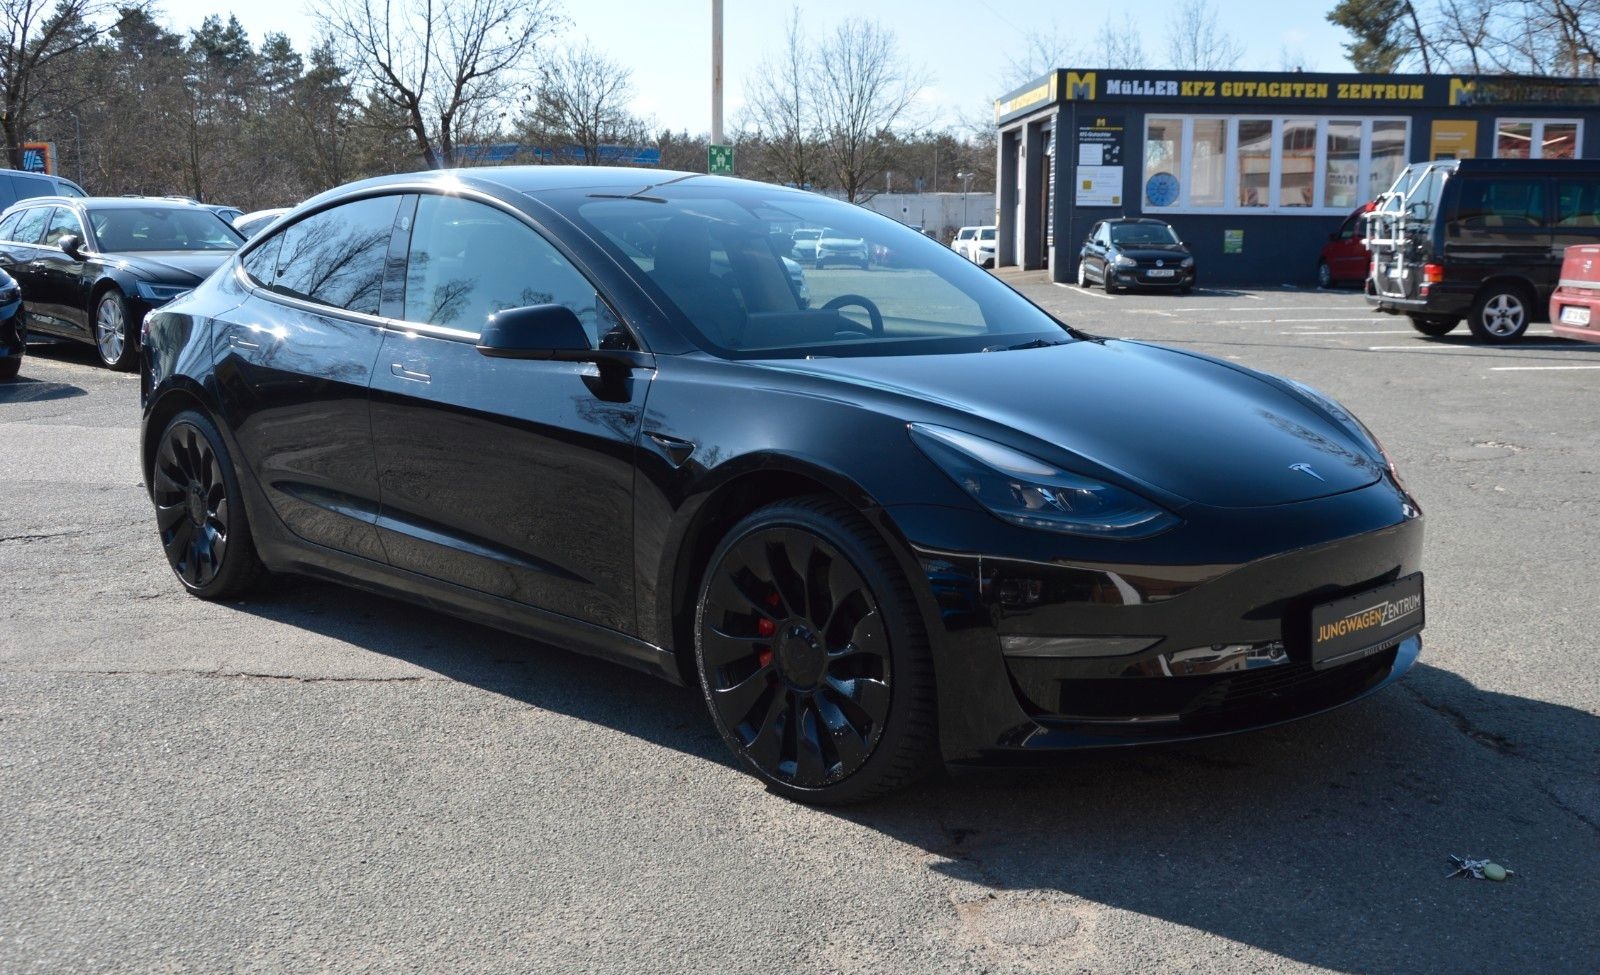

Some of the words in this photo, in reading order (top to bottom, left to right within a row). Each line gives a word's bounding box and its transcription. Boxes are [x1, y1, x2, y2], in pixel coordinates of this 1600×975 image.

[1181, 81, 1216, 97] KFZ
[1221, 82, 1329, 98] GUTACHTEN
[1337, 83, 1424, 100] ZENTRUM
